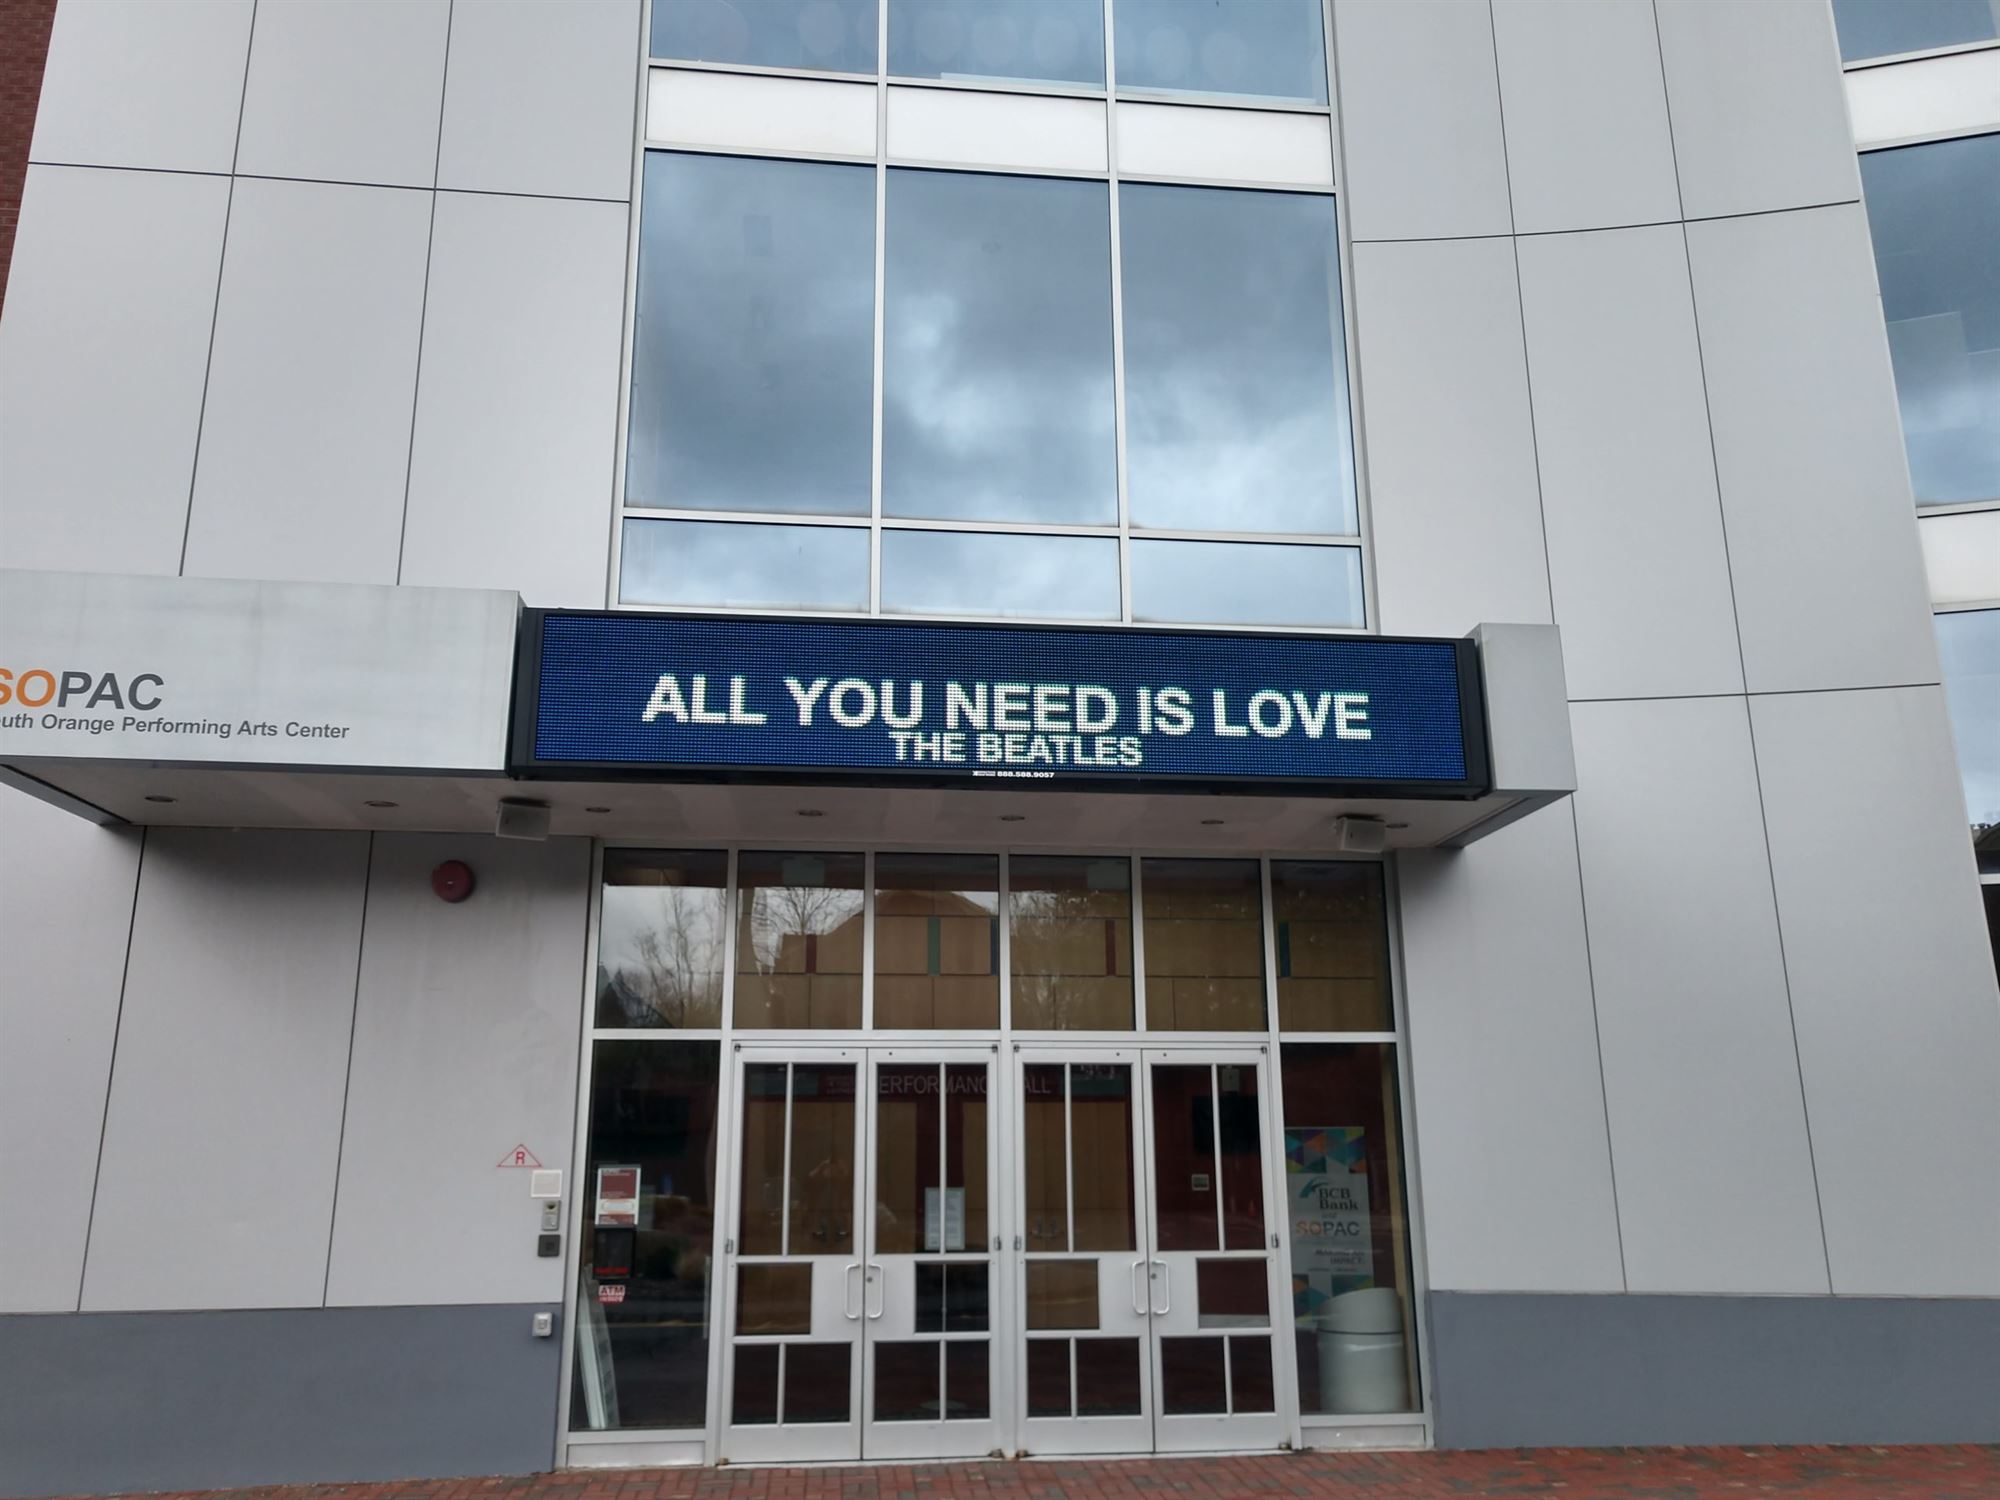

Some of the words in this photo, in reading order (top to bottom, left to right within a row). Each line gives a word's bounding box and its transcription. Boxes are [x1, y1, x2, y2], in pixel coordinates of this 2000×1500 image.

[642, 673, 767, 724] ALL
[783, 677, 923, 728] YOU
[945, 680, 1118, 734] NEED
[1136, 686, 1195, 736] IS
[1213, 688, 1372, 741] LOVE
[41, 714, 115, 735] Orange
[122, 717, 231, 739] Performing
[237, 720, 278, 737] Arts
[285, 721, 350, 739] Center
[889, 730, 966, 763] THE
[976, 734, 1142, 767] BEATLES
[515, 1151, 525, 1165] R
[1318, 1187, 1351, 1199] BCB
[1319, 1199, 1359, 1211] Bank
[1296, 1221, 1360, 1236] SOPAC
